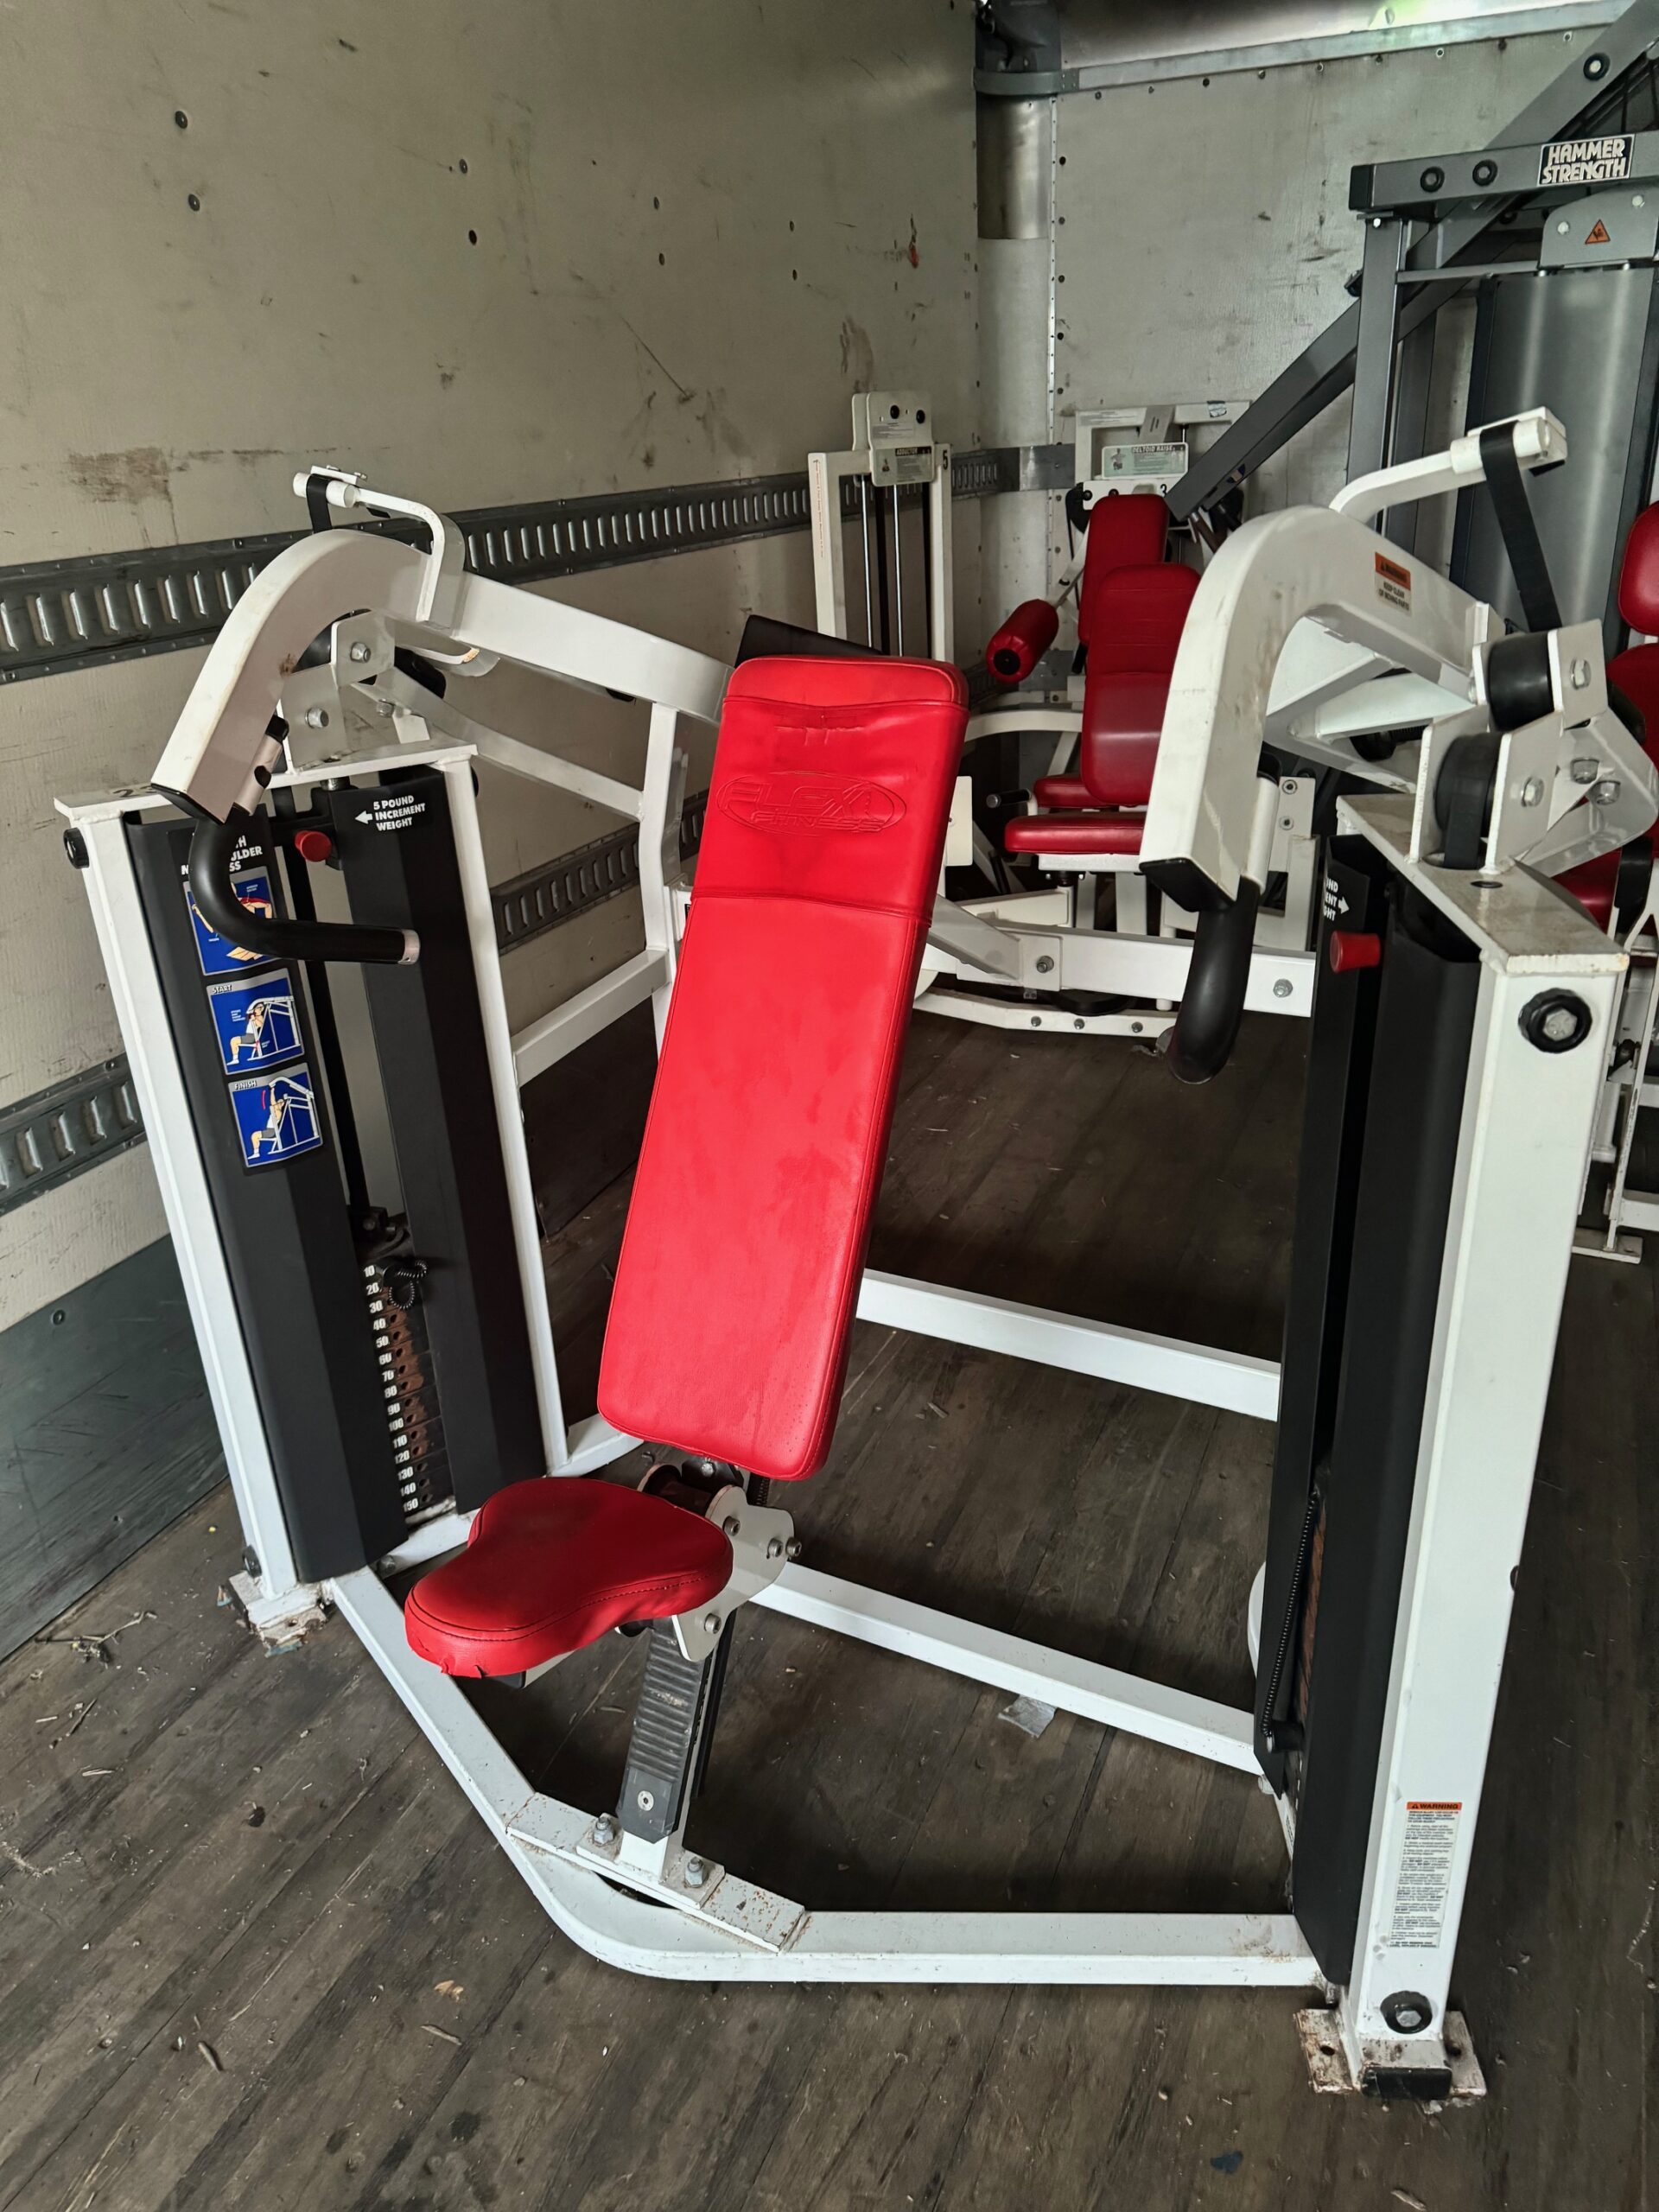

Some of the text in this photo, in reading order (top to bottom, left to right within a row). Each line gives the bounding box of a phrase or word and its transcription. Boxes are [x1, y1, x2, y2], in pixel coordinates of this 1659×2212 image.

[1548, 138, 1625, 166] HAMMER
[1541, 157, 1626, 184] STRENGTH
[943, 450, 949, 470] 5
[373, 795, 415, 810] 5 POUND
[375, 803, 426, 821] INCREMENT
[376, 817, 413, 831] WEIGHT
[213, 984, 232, 995] START
[234, 1080, 257, 1090] FINISH
[364, 1265, 375, 1277] 10
[365, 1282, 379, 1295] 20
[369, 1300, 383, 1313] 30
[373, 1318, 386, 1331] 40
[376, 1335, 389, 1348] 50
[378, 1352, 392, 1365] 60
[382, 1370, 395, 1382] 70
[384, 1385, 397, 1398] 80
[387, 1402, 401, 1415] 90
[389, 1417, 404, 1432] 100
[392, 1434, 408, 1449] 110
[394, 1450, 410, 1464] 120
[397, 1466, 414, 1481] 130
[400, 1482, 416, 1497] 140
[404, 1497, 419, 1512] 150
